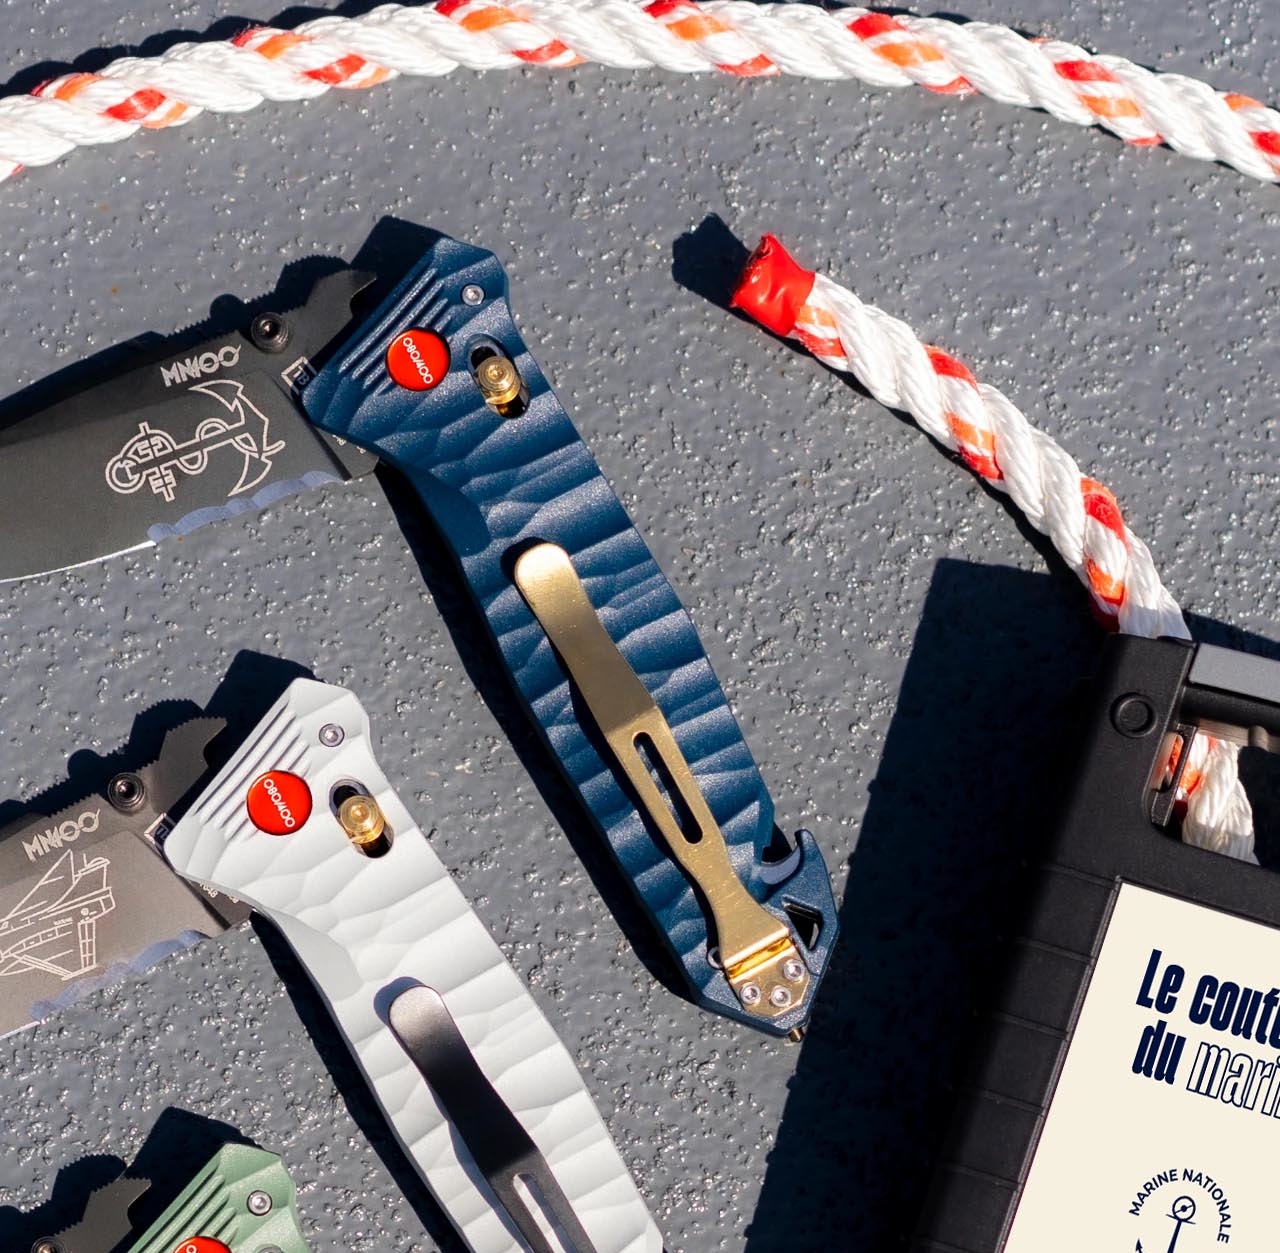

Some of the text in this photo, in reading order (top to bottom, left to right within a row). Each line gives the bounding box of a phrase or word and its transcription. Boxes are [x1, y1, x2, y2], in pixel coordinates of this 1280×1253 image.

[403, 337, 434, 384] 080/400
[264, 778, 296, 828] 080/400
[1136, 948, 1186, 1014] Le
[1131, 1019, 1187, 1085] du
[1128, 1168, 1232, 1244] MARINE NATIONALE
